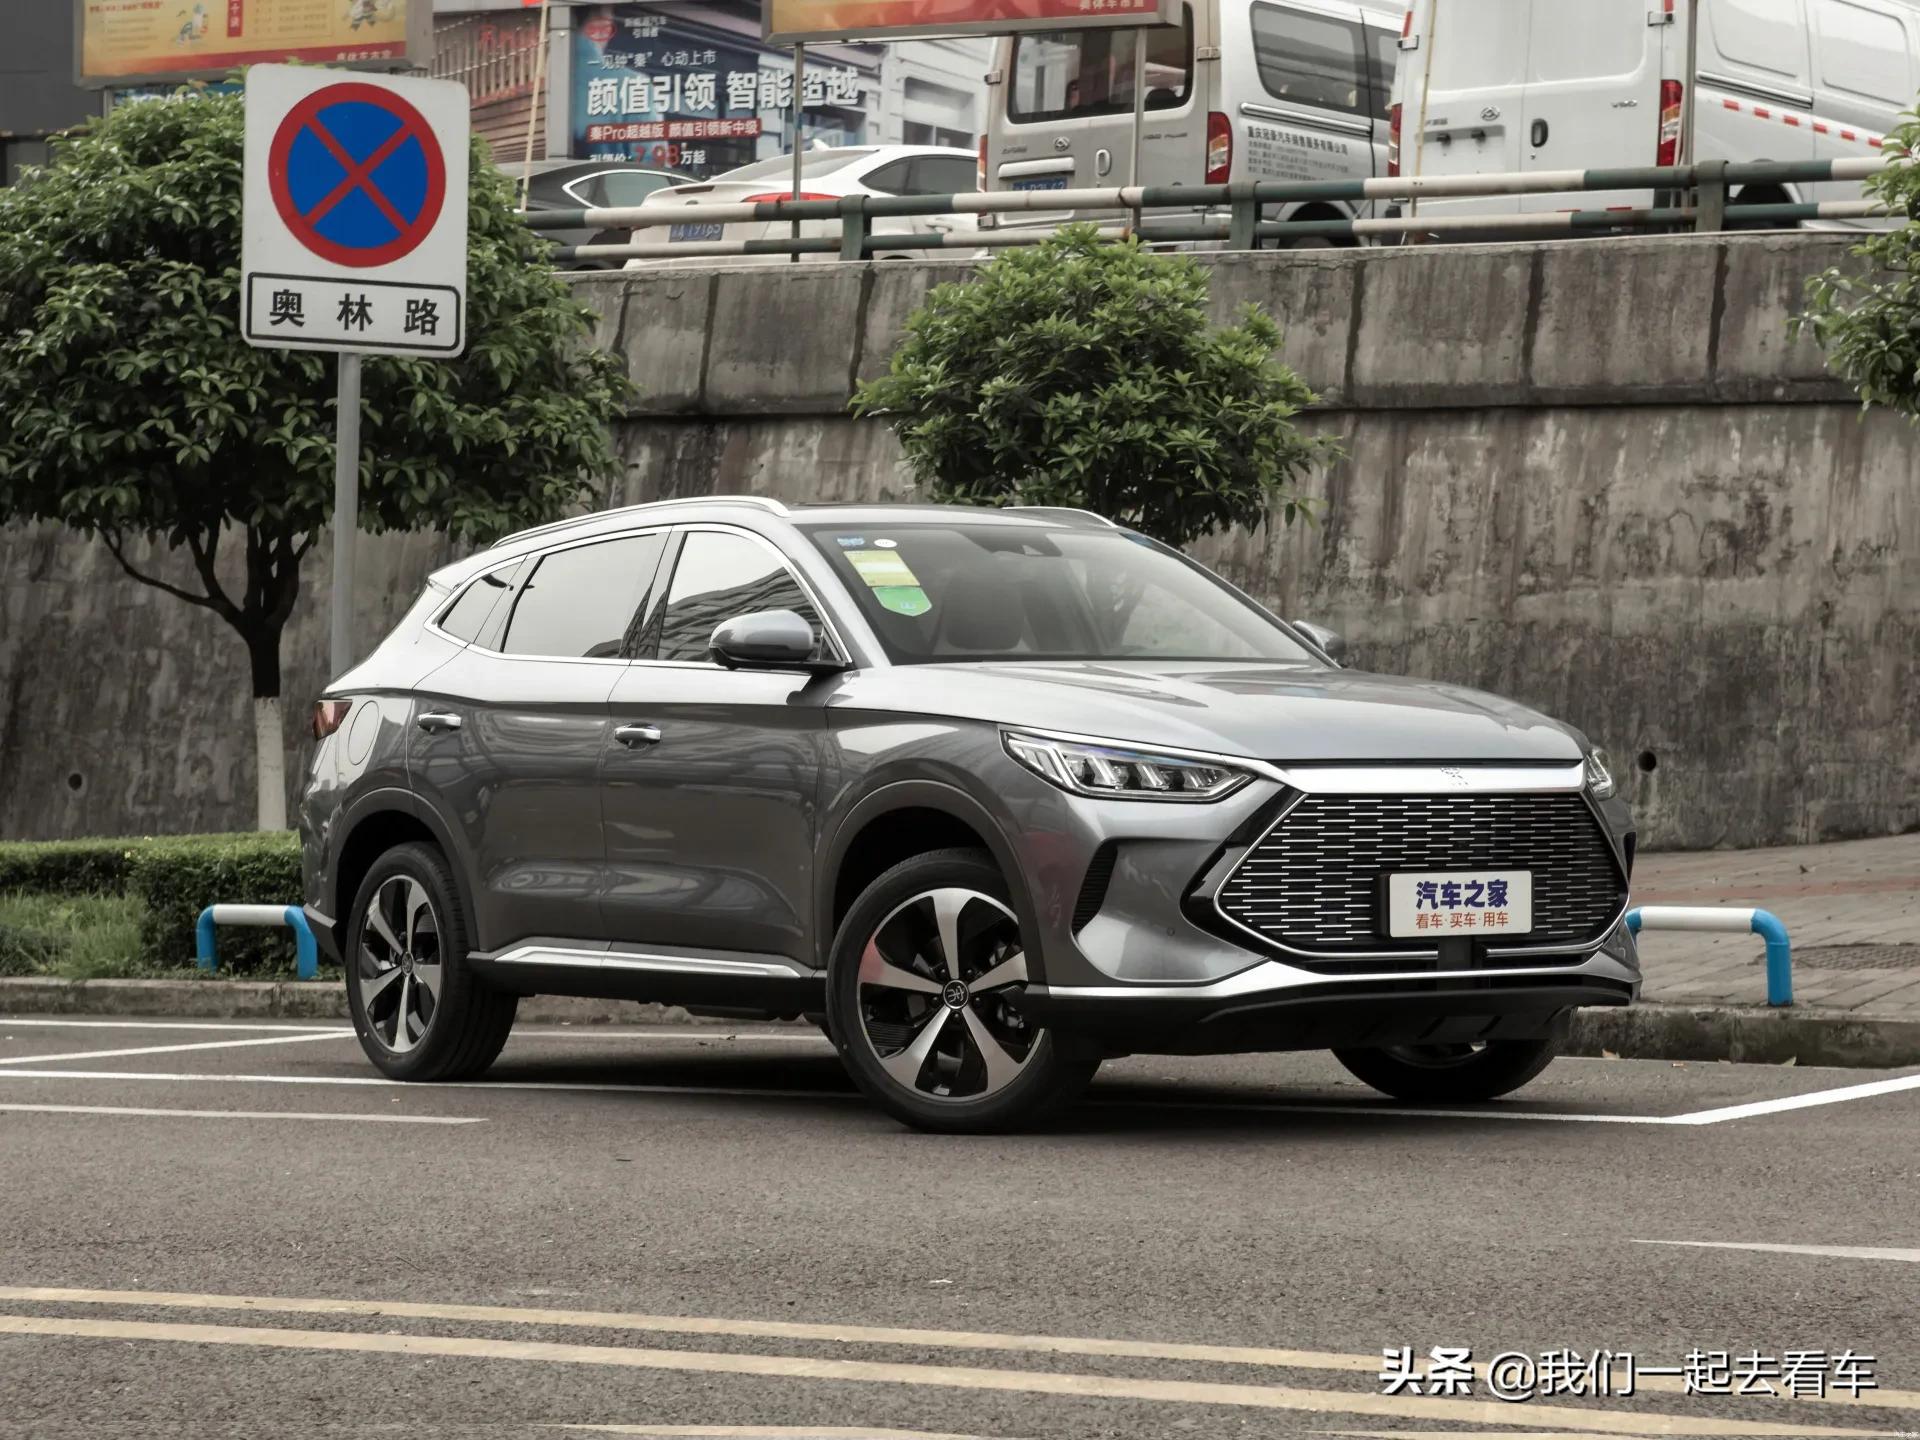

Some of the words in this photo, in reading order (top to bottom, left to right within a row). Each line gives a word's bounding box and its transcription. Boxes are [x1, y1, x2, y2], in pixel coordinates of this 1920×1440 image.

[660, 49, 717, 67] 心动上市
[587, 72, 717, 116] 颜值引领
[726, 66, 859, 111] 智能超越
[590, 124, 664, 142] 秦Pro超越版
[667, 120, 759, 138] 颜值引领新中级
[269, 289, 440, 337] 奥林路
[1415, 879, 1508, 910] 汽车之家
